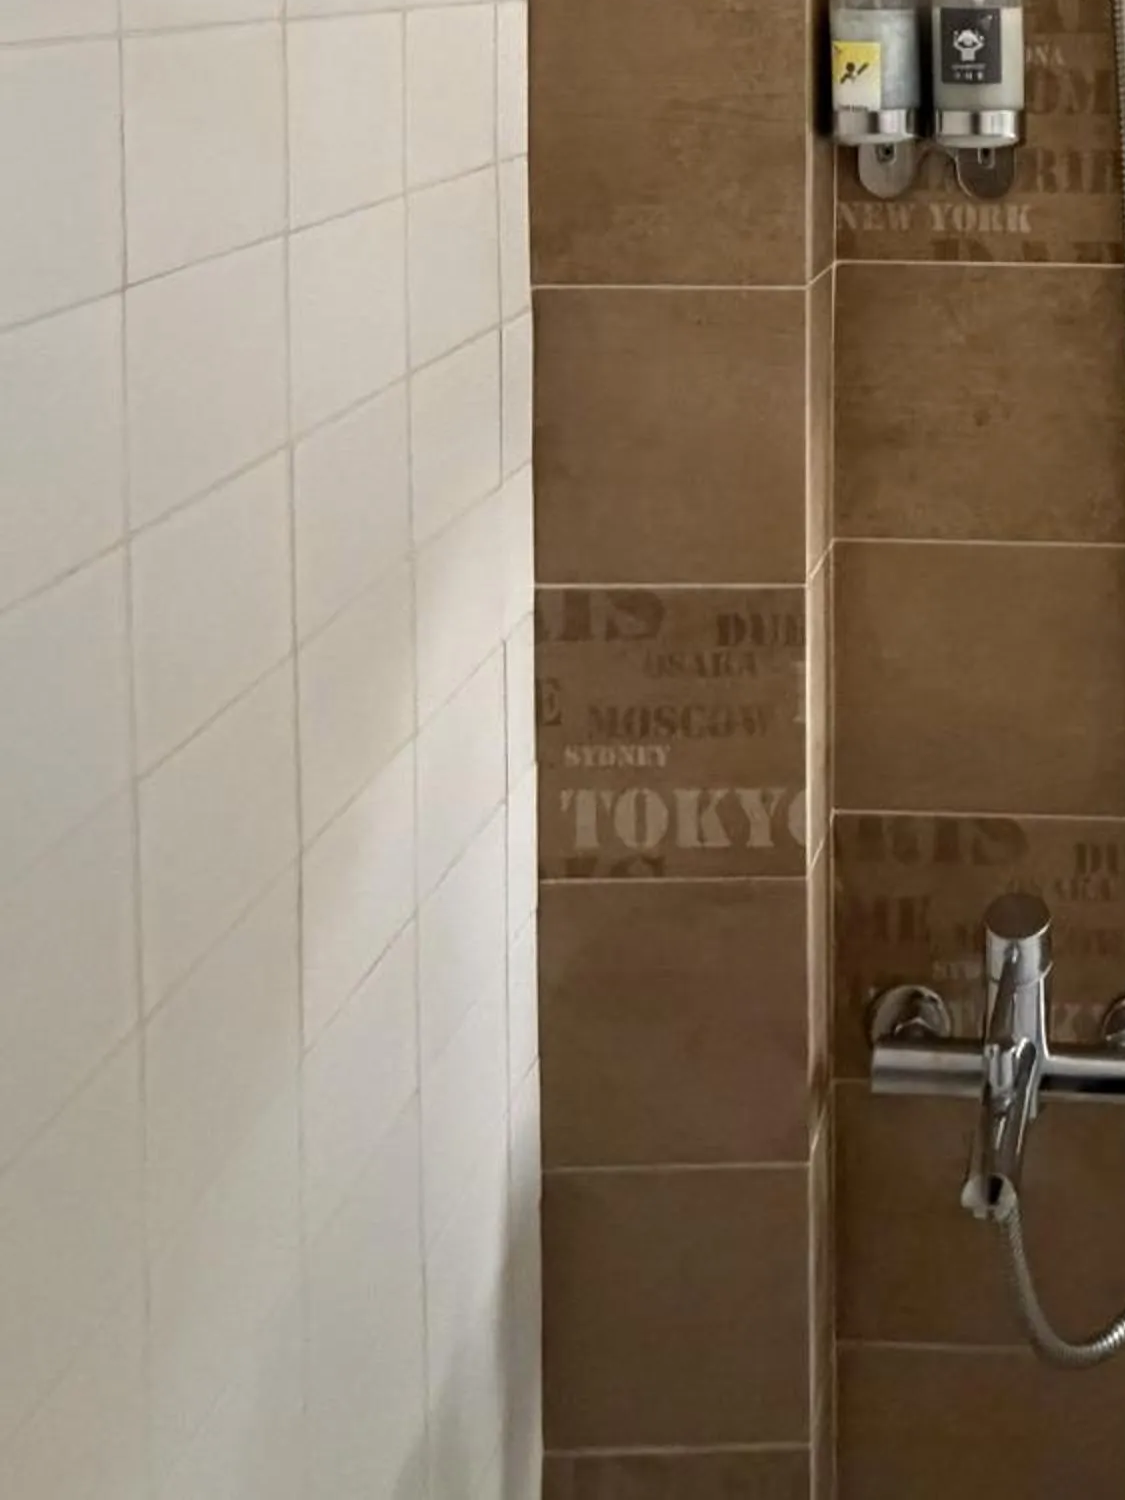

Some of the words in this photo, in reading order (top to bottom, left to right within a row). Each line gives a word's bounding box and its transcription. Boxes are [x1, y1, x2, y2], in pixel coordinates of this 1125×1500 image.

[838, 202, 914, 233] NEW
[929, 202, 1033, 234] YORK
[563, 743, 671, 768] SYDNEY
